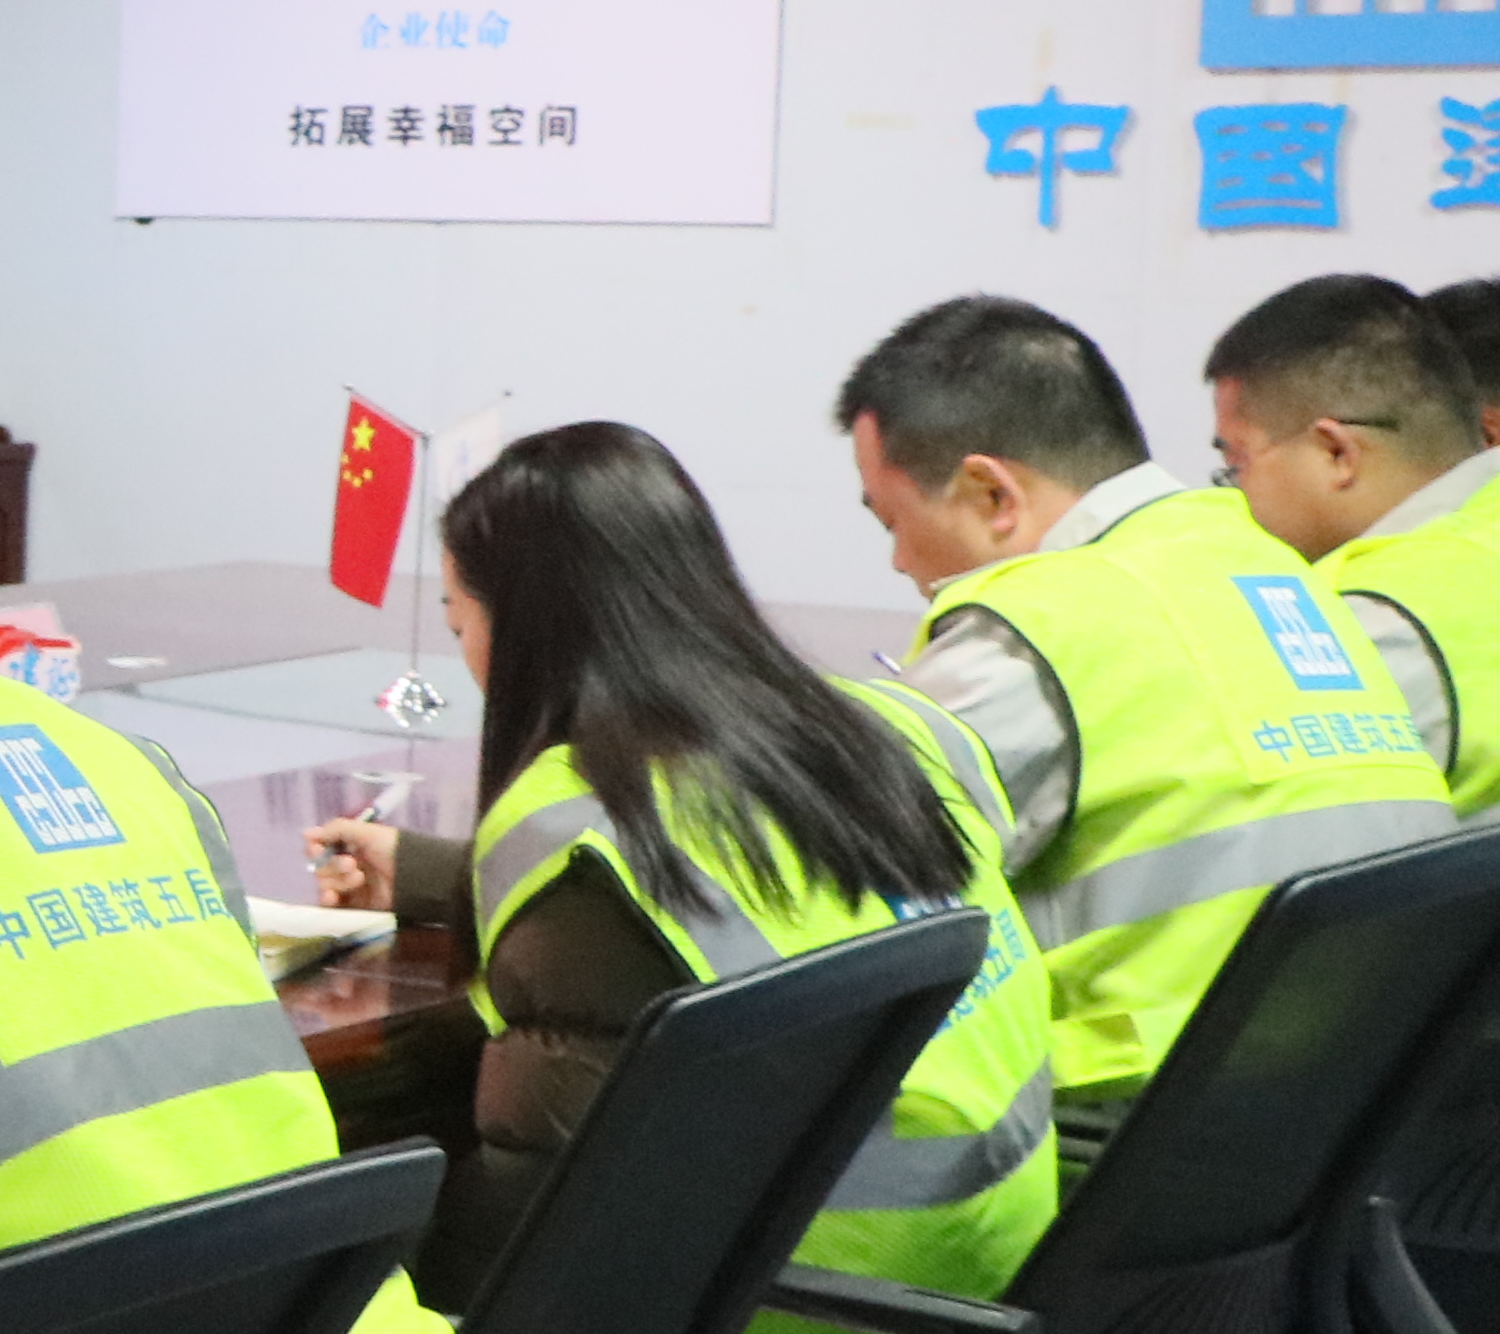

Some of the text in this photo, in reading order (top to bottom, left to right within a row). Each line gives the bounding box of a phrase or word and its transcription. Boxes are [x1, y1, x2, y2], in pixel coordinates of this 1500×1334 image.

[360, 10, 512, 50] 企业使命
[288, 104, 578, 148] 拓展幸福空间
